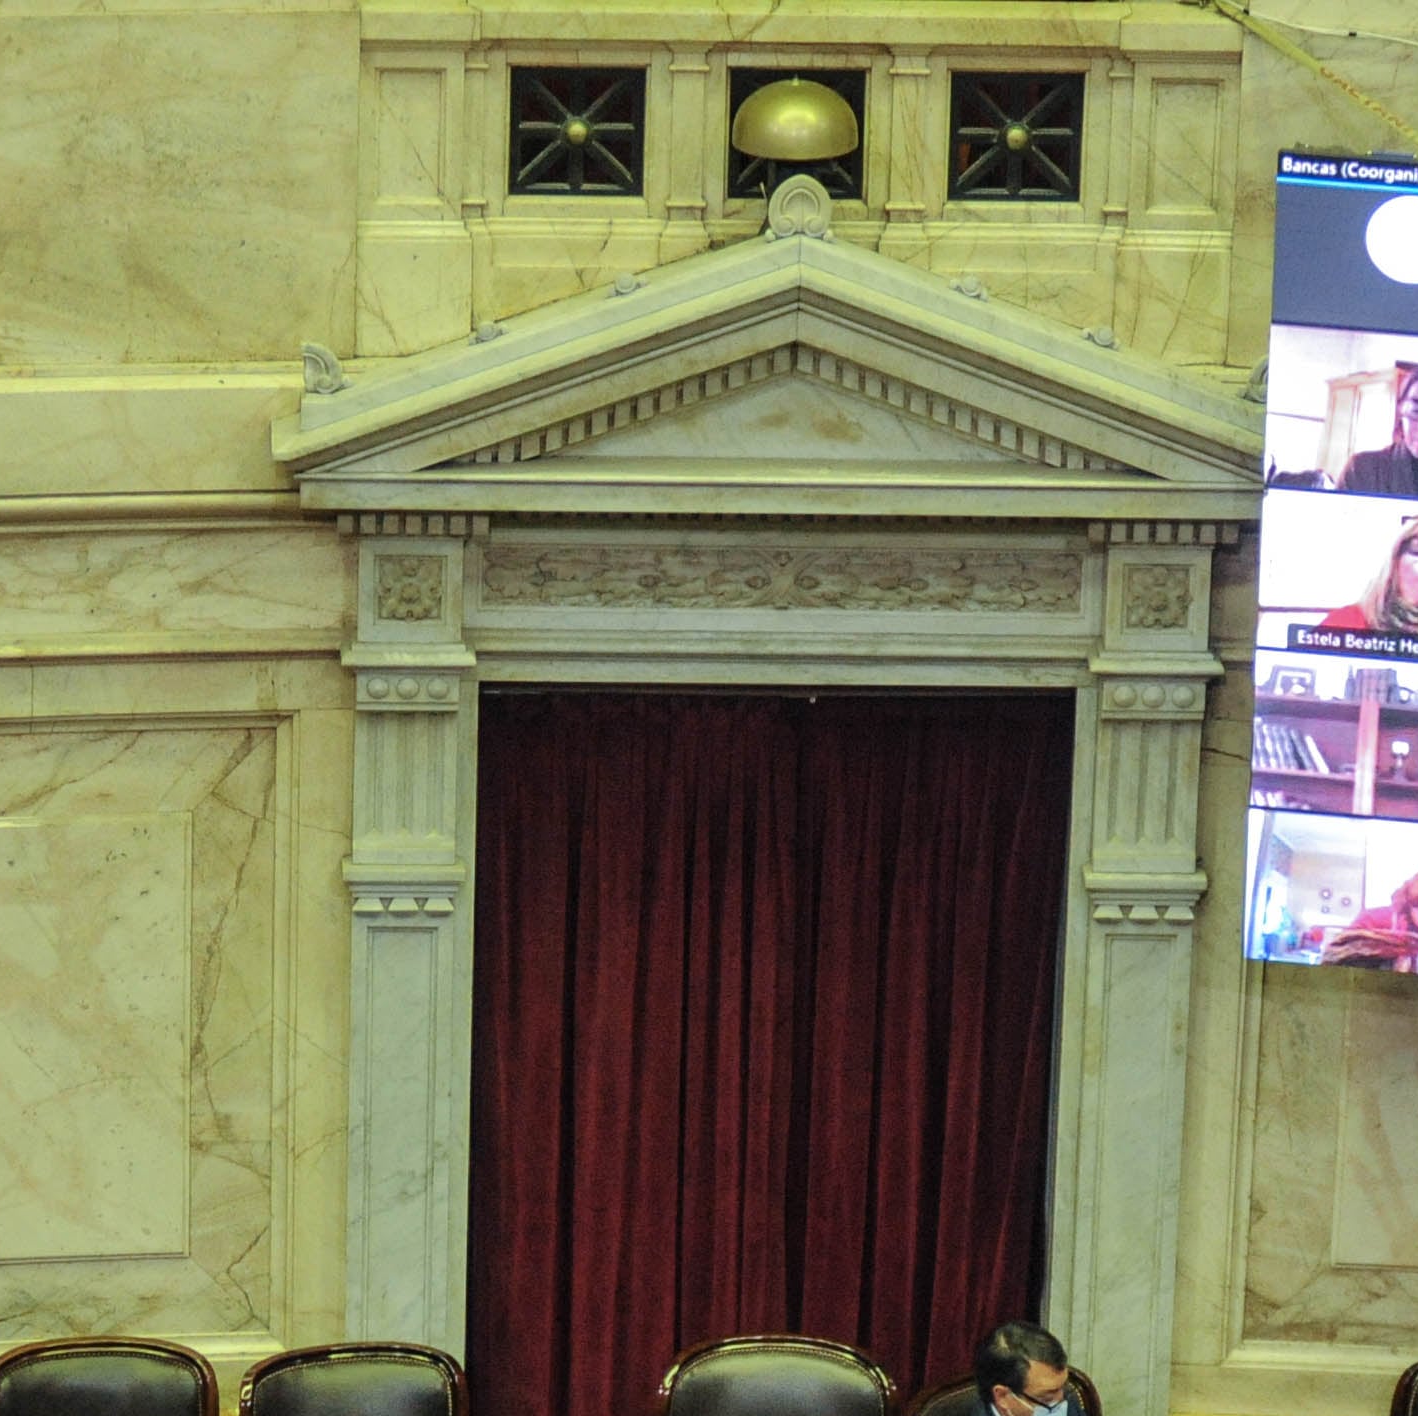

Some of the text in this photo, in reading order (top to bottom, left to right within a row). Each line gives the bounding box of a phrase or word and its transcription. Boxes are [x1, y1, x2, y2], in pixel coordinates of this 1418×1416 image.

[1282, 157, 1337, 175] Bancas
[1297, 630, 1341, 646] Estela
[1345, 633, 1396, 652] Beatriz
